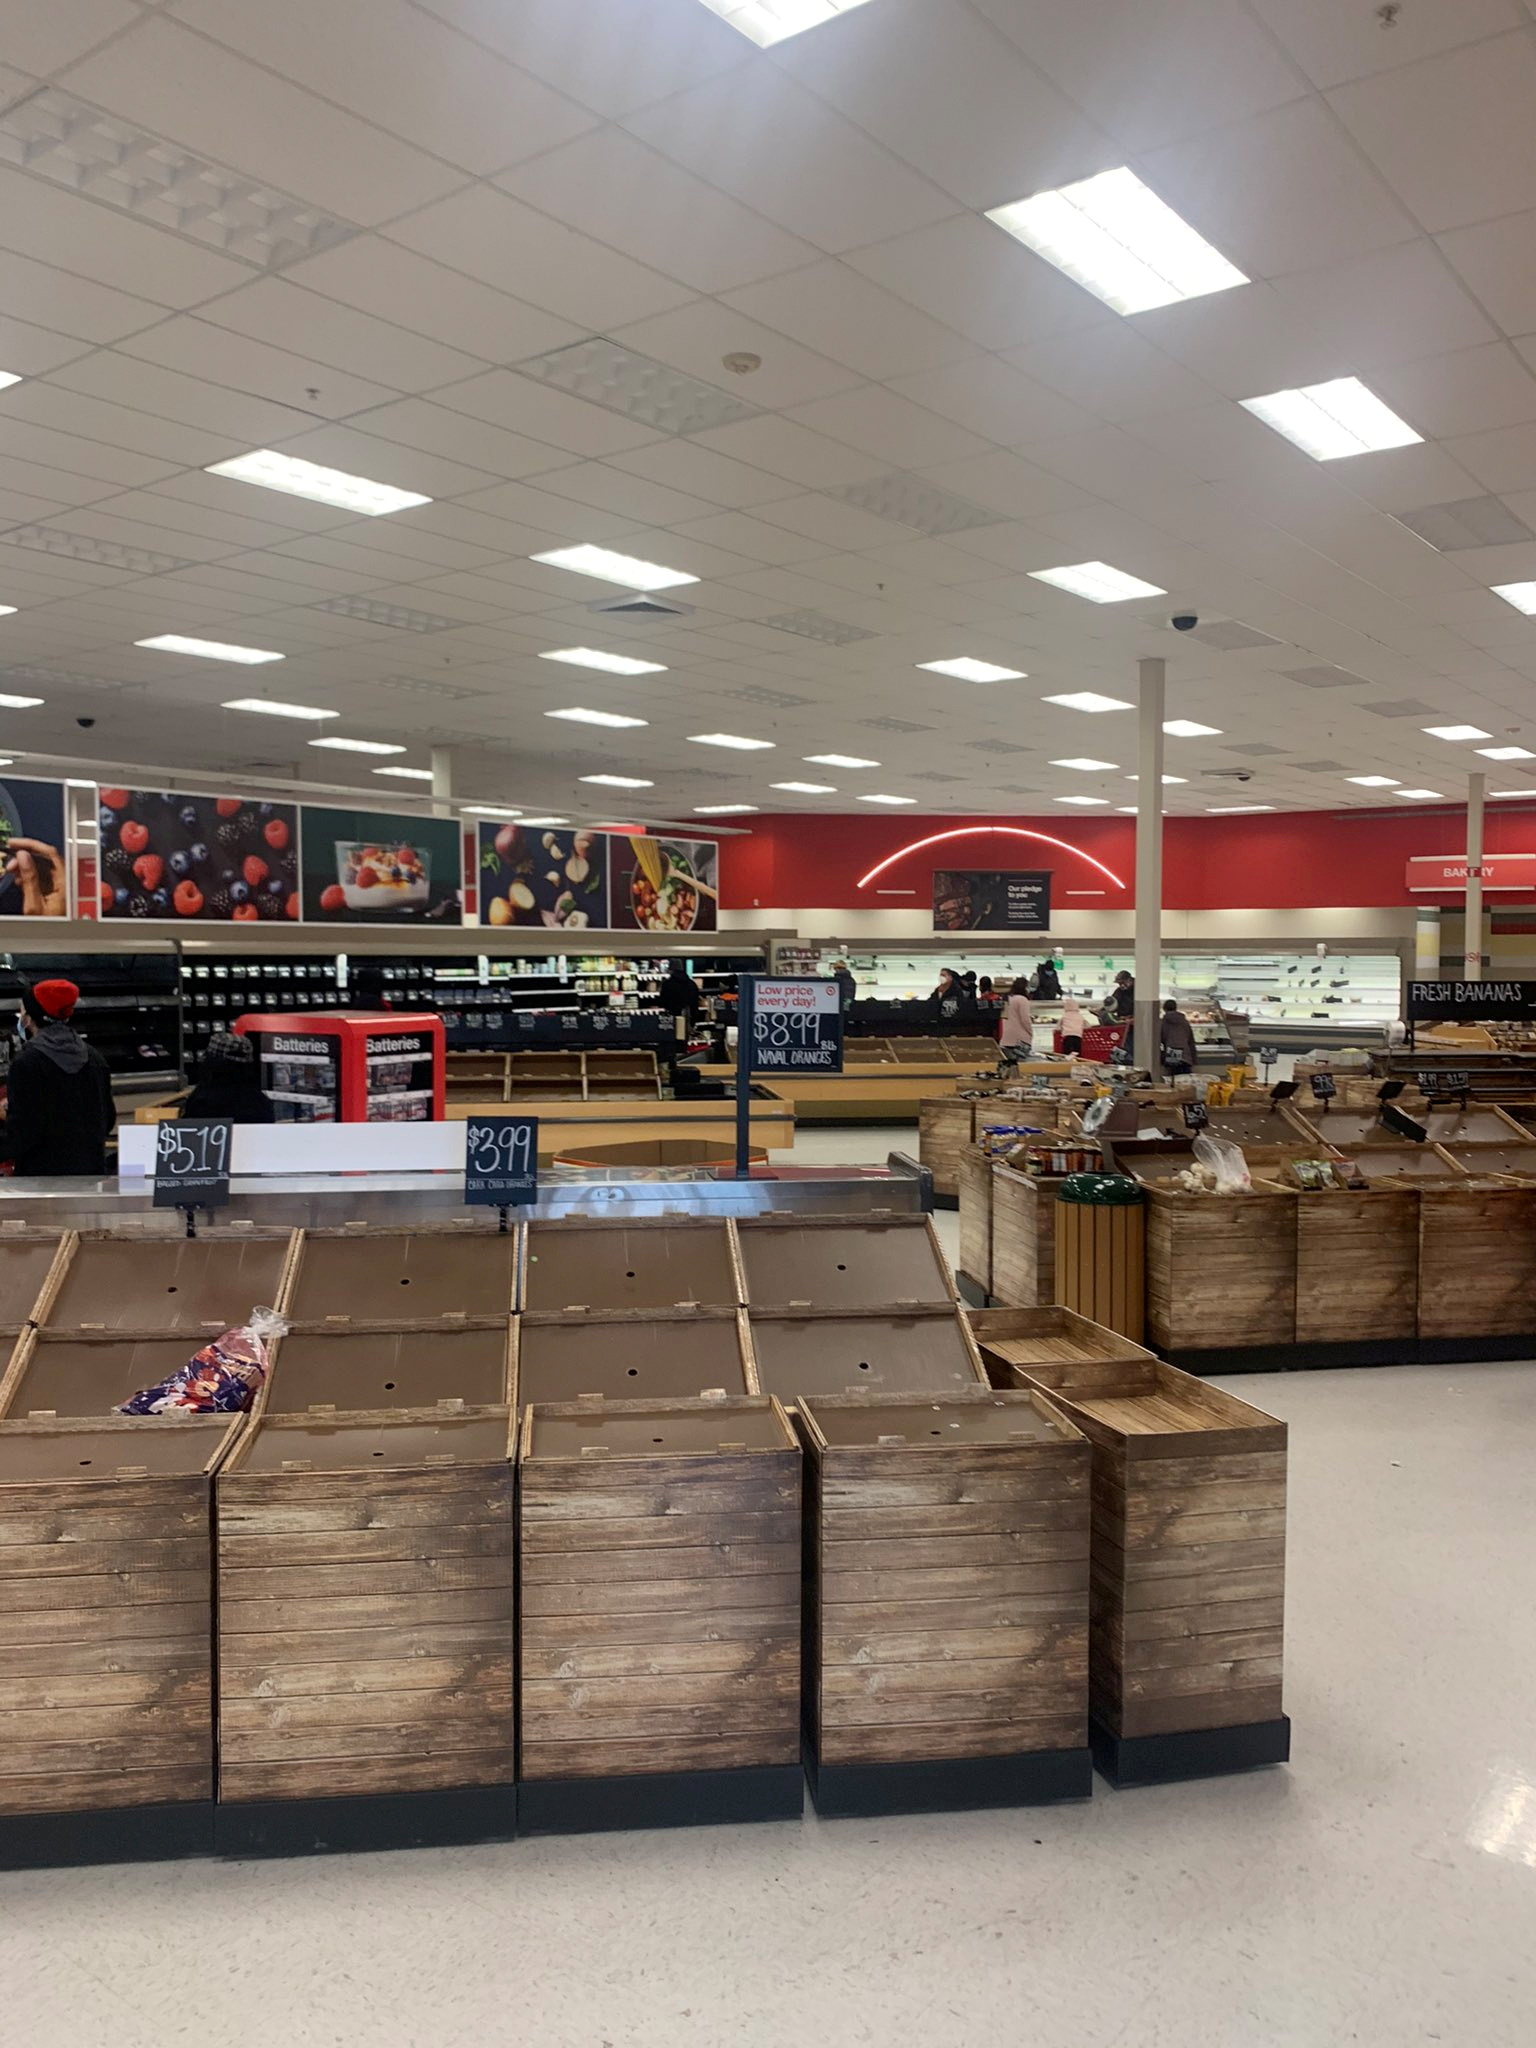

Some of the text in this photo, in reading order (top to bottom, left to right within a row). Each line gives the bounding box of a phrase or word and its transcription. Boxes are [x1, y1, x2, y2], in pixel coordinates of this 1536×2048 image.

[758, 984, 814, 997] Low price
[1412, 983, 1522, 1002] FRESH BANANAS
[757, 996, 816, 1008] every day!
[754, 1013, 821, 1047] $8.99
[273, 1036, 329, 1053] Batteries
[366, 1036, 421, 1053] Batteries
[791, 1051, 832, 1065] ORANGES
[158, 1122, 227, 1174] $5.19
[468, 1125, 531, 1173] $3.99
